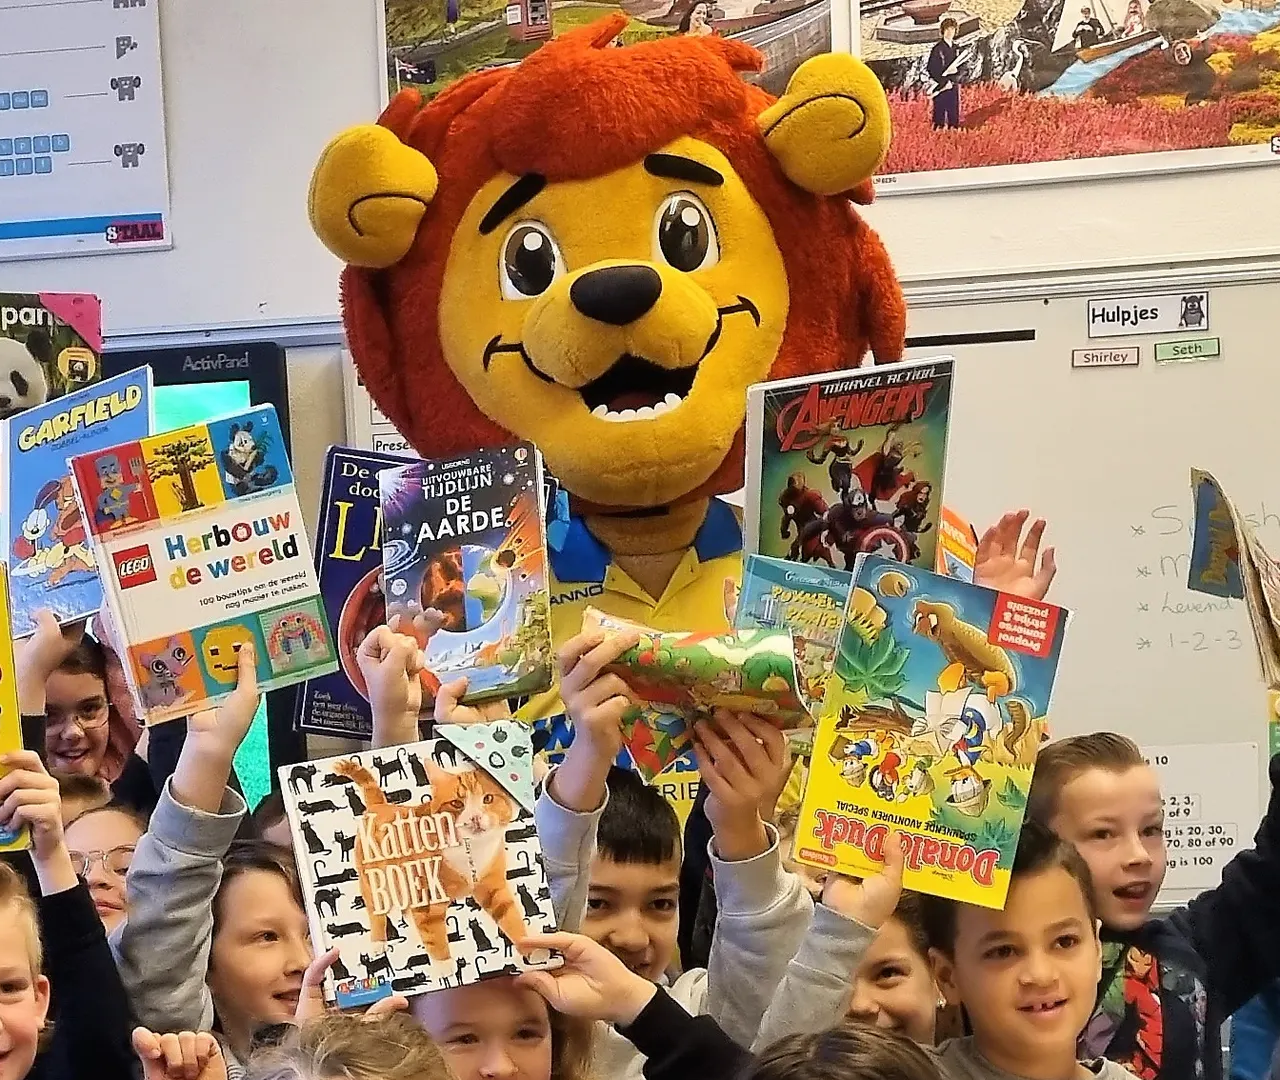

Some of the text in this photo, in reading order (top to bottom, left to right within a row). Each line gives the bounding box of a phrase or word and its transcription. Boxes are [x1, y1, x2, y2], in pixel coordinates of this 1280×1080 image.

[1, 300, 63, 331] pan
[1091, 303, 1160, 327] Hulpjes
[1083, 349, 1129, 365] Shirley
[1172, 342, 1203, 356] Seth
[182, 353, 250, 372] ActivPanel
[18, 384, 142, 453] GARFIELD
[777, 381, 933, 452] AVENGERS
[375, 440, 410, 452] Prese
[341, 462, 369, 477] De
[422, 463, 492, 486] UITVOUWBARE
[422, 473, 493, 500] TIJDLIJN
[445, 496, 472, 515] DE
[417, 506, 506, 543] AARDE
[164, 511, 291, 561] Herbouw
[119, 556, 151, 578] LEGO
[169, 533, 299, 590] de wereld
[199, 594, 215, 606] 100
[998, 632, 1041, 652] propvol
[1155, 755, 1169, 766] 10
[836, 800, 869, 817] SPECIAL
[1169, 808, 1191, 818] of 9
[814, 808, 889, 863] Duck
[871, 810, 978, 843] SPANNENDE AVONTUREN
[1187, 826, 1205, 836] 20,
[1208, 825, 1226, 835] 30,
[357, 810, 459, 865] Katten
[1187, 838, 1202, 847] 80
[1205, 837, 1216, 847] of
[1219, 837, 1234, 846] 90
[1180, 856, 1213, 866] is 100
[363, 856, 450, 916] BOEK
